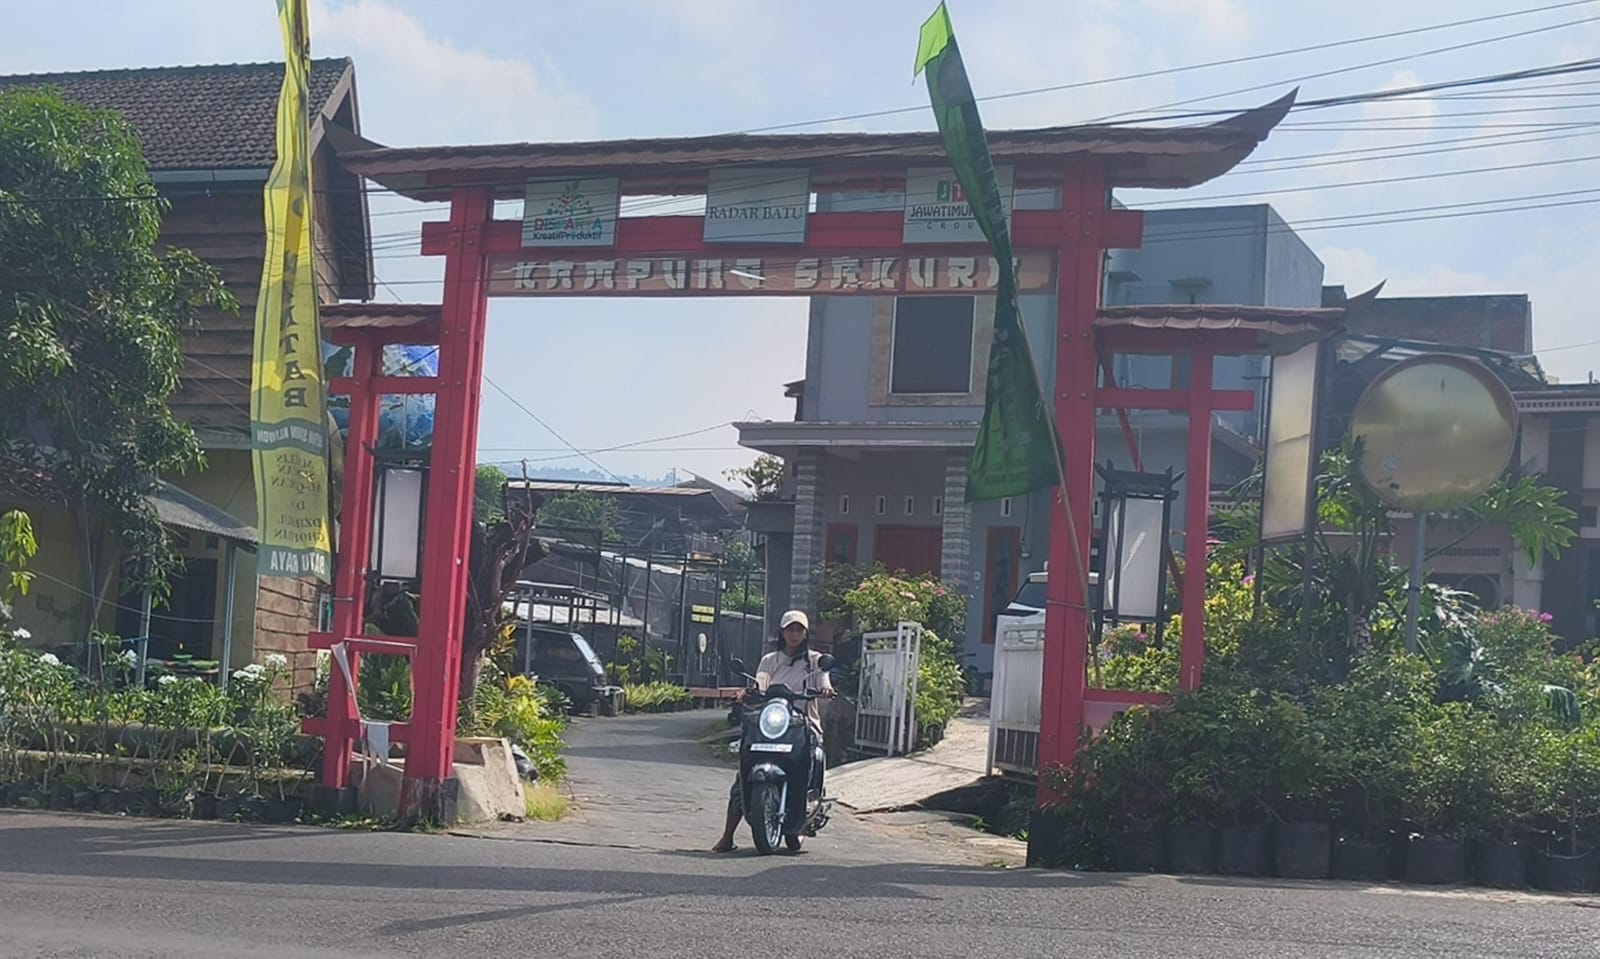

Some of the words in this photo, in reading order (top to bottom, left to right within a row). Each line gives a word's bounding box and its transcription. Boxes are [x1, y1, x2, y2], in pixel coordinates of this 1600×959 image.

[709, 207, 757, 220] RADAR
[763, 206, 803, 220] BATU
[927, 222, 974, 230] GROU
[514, 258, 763, 289] KAMPUNG
